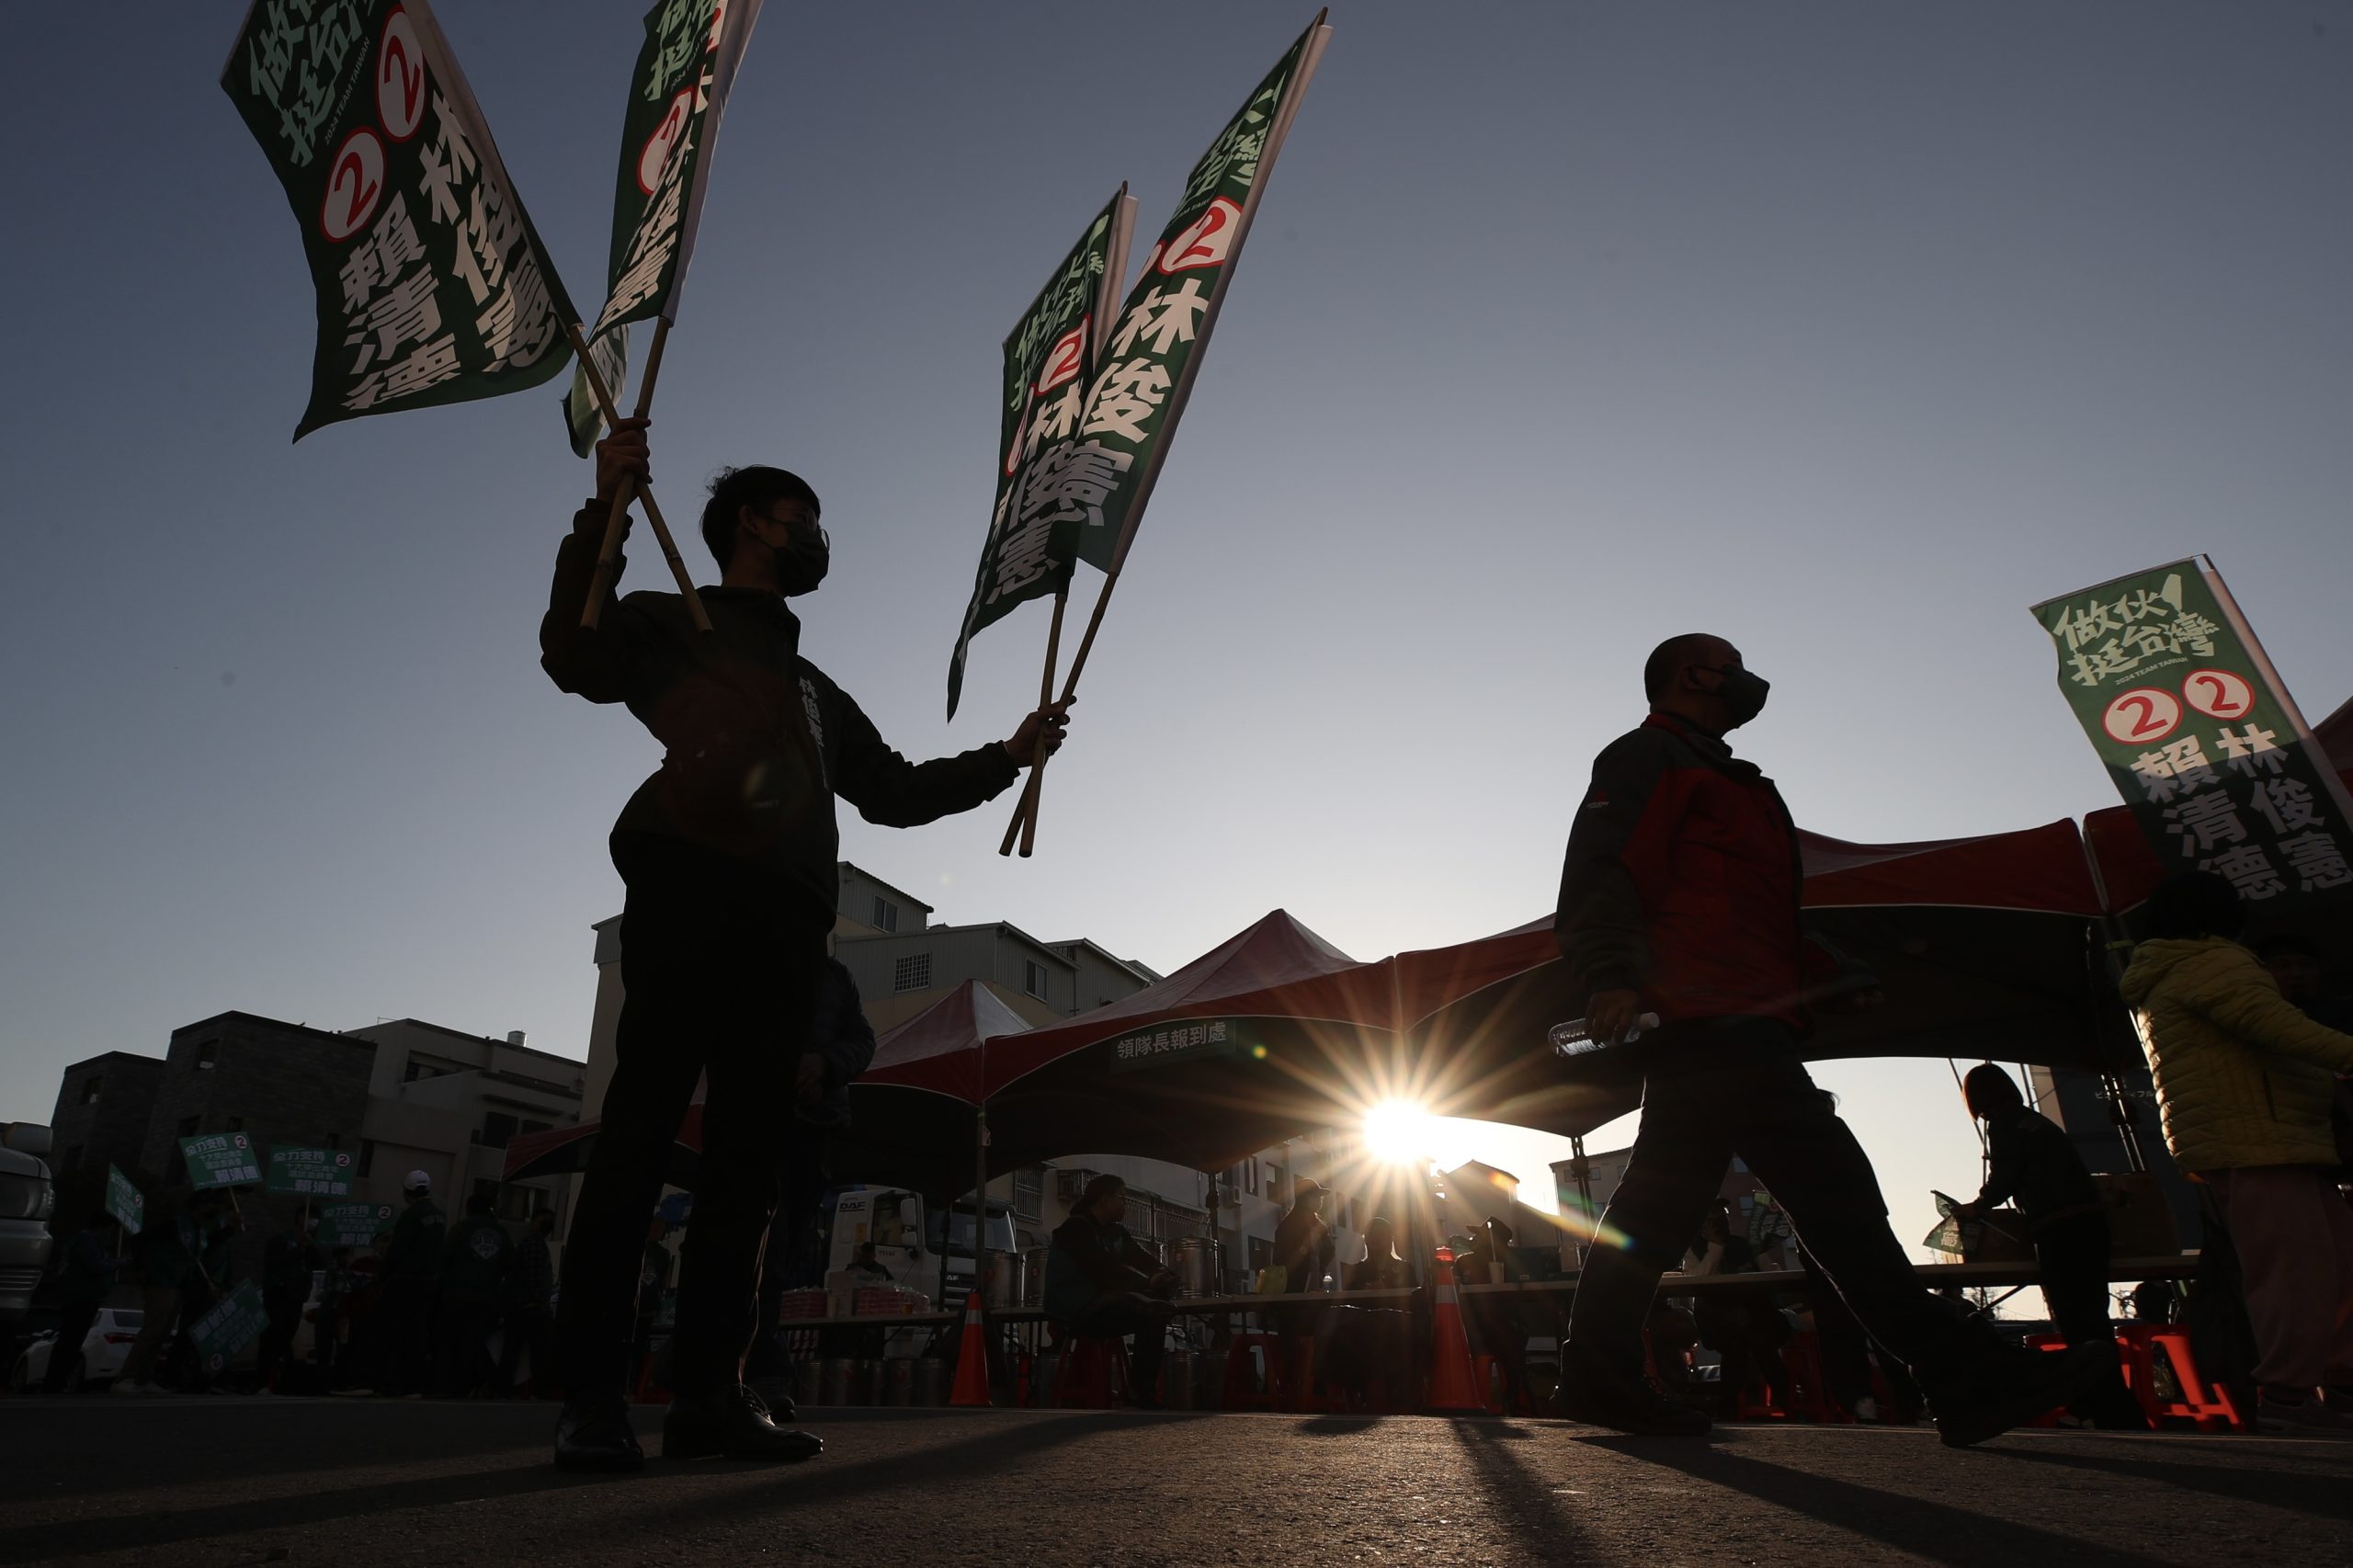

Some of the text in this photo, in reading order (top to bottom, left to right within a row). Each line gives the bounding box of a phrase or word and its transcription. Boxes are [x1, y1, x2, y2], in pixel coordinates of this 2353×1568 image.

[335, 85, 355, 117] TEAM
[350, 37, 371, 85] TAIWAN
[338, 189, 461, 411] 賴清德
[1054, 278, 1211, 528] 林俊憲
[2052, 574, 2183, 651] 做伙!
[2066, 611, 2221, 687] 挺台灣
[2114, 656, 2188, 686] 2024 TEAM TAIWAN
[2130, 734, 2288, 902] 賴清德
[2214, 722, 2353, 893] 林俊憲
[1117, 1021, 1227, 1060] 領隊長報到處
[839, 1200, 866, 1210] DAF
